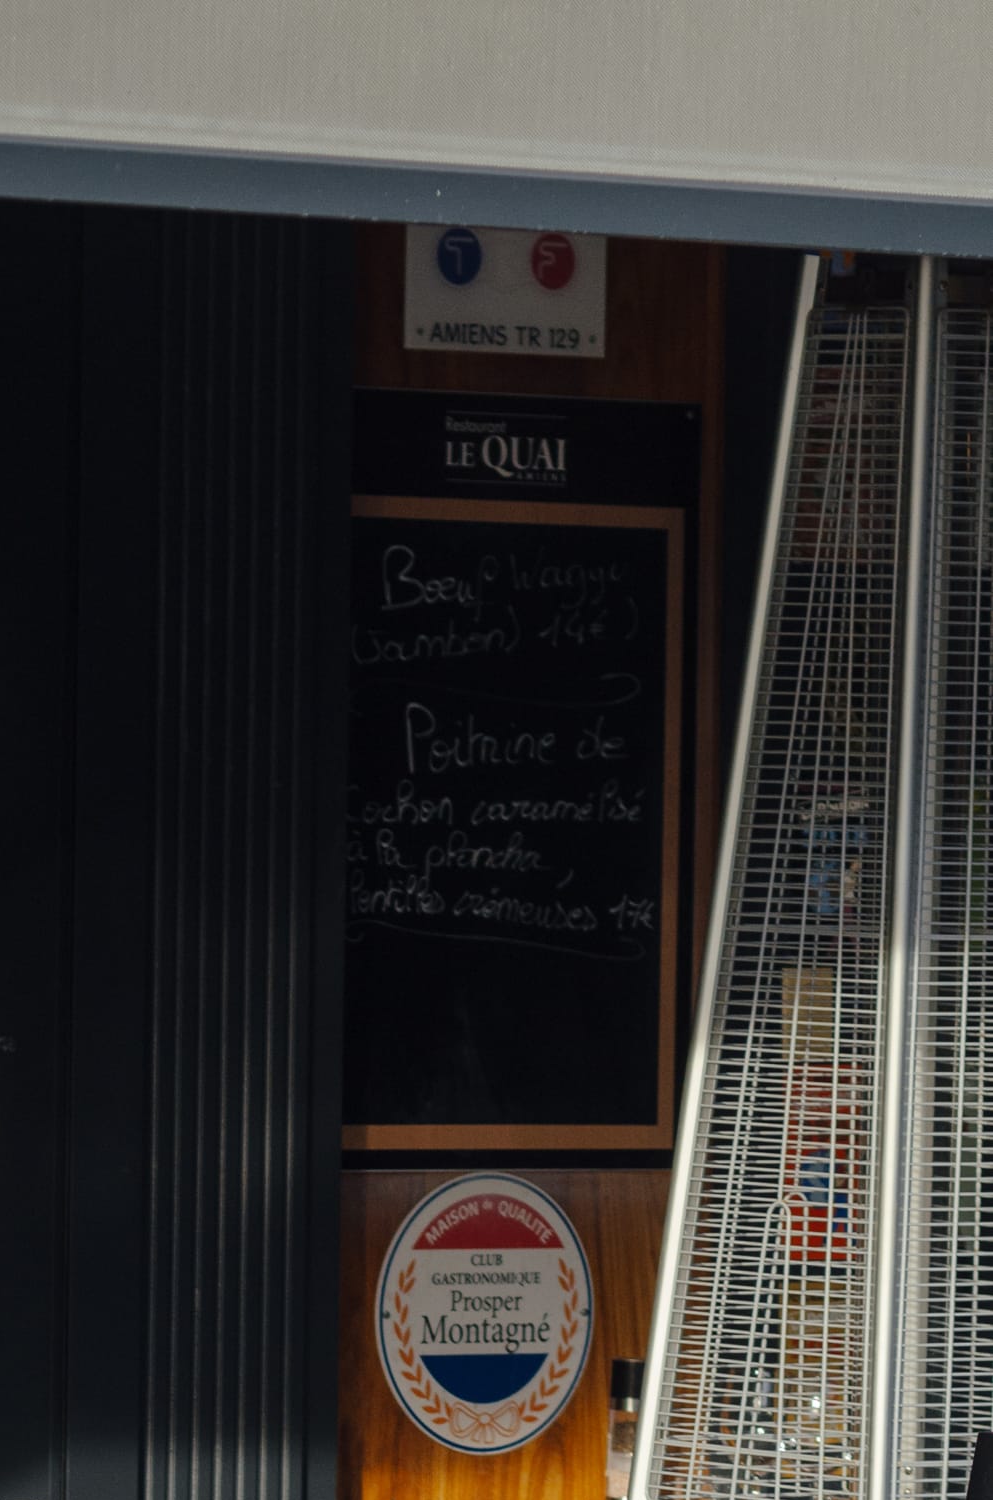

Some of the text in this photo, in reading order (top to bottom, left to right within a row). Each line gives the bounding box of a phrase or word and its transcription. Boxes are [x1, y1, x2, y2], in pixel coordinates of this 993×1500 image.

[429, 323, 581, 349] AMIENS TR 129
[446, 416, 507, 433] Restaurant
[445, 435, 567, 478] LE QUAI
[405, 701, 630, 774] Poitrine de
[425, 1200, 480, 1245] MAISON
[497, 1200, 554, 1244] QUALITÉ
[470, 1253, 503, 1266] CLUB
[431, 1271, 541, 1286] GASTRONOMIQUE
[450, 1289, 523, 1318] Prosper
[420, 1312, 551, 1354] Montagné
